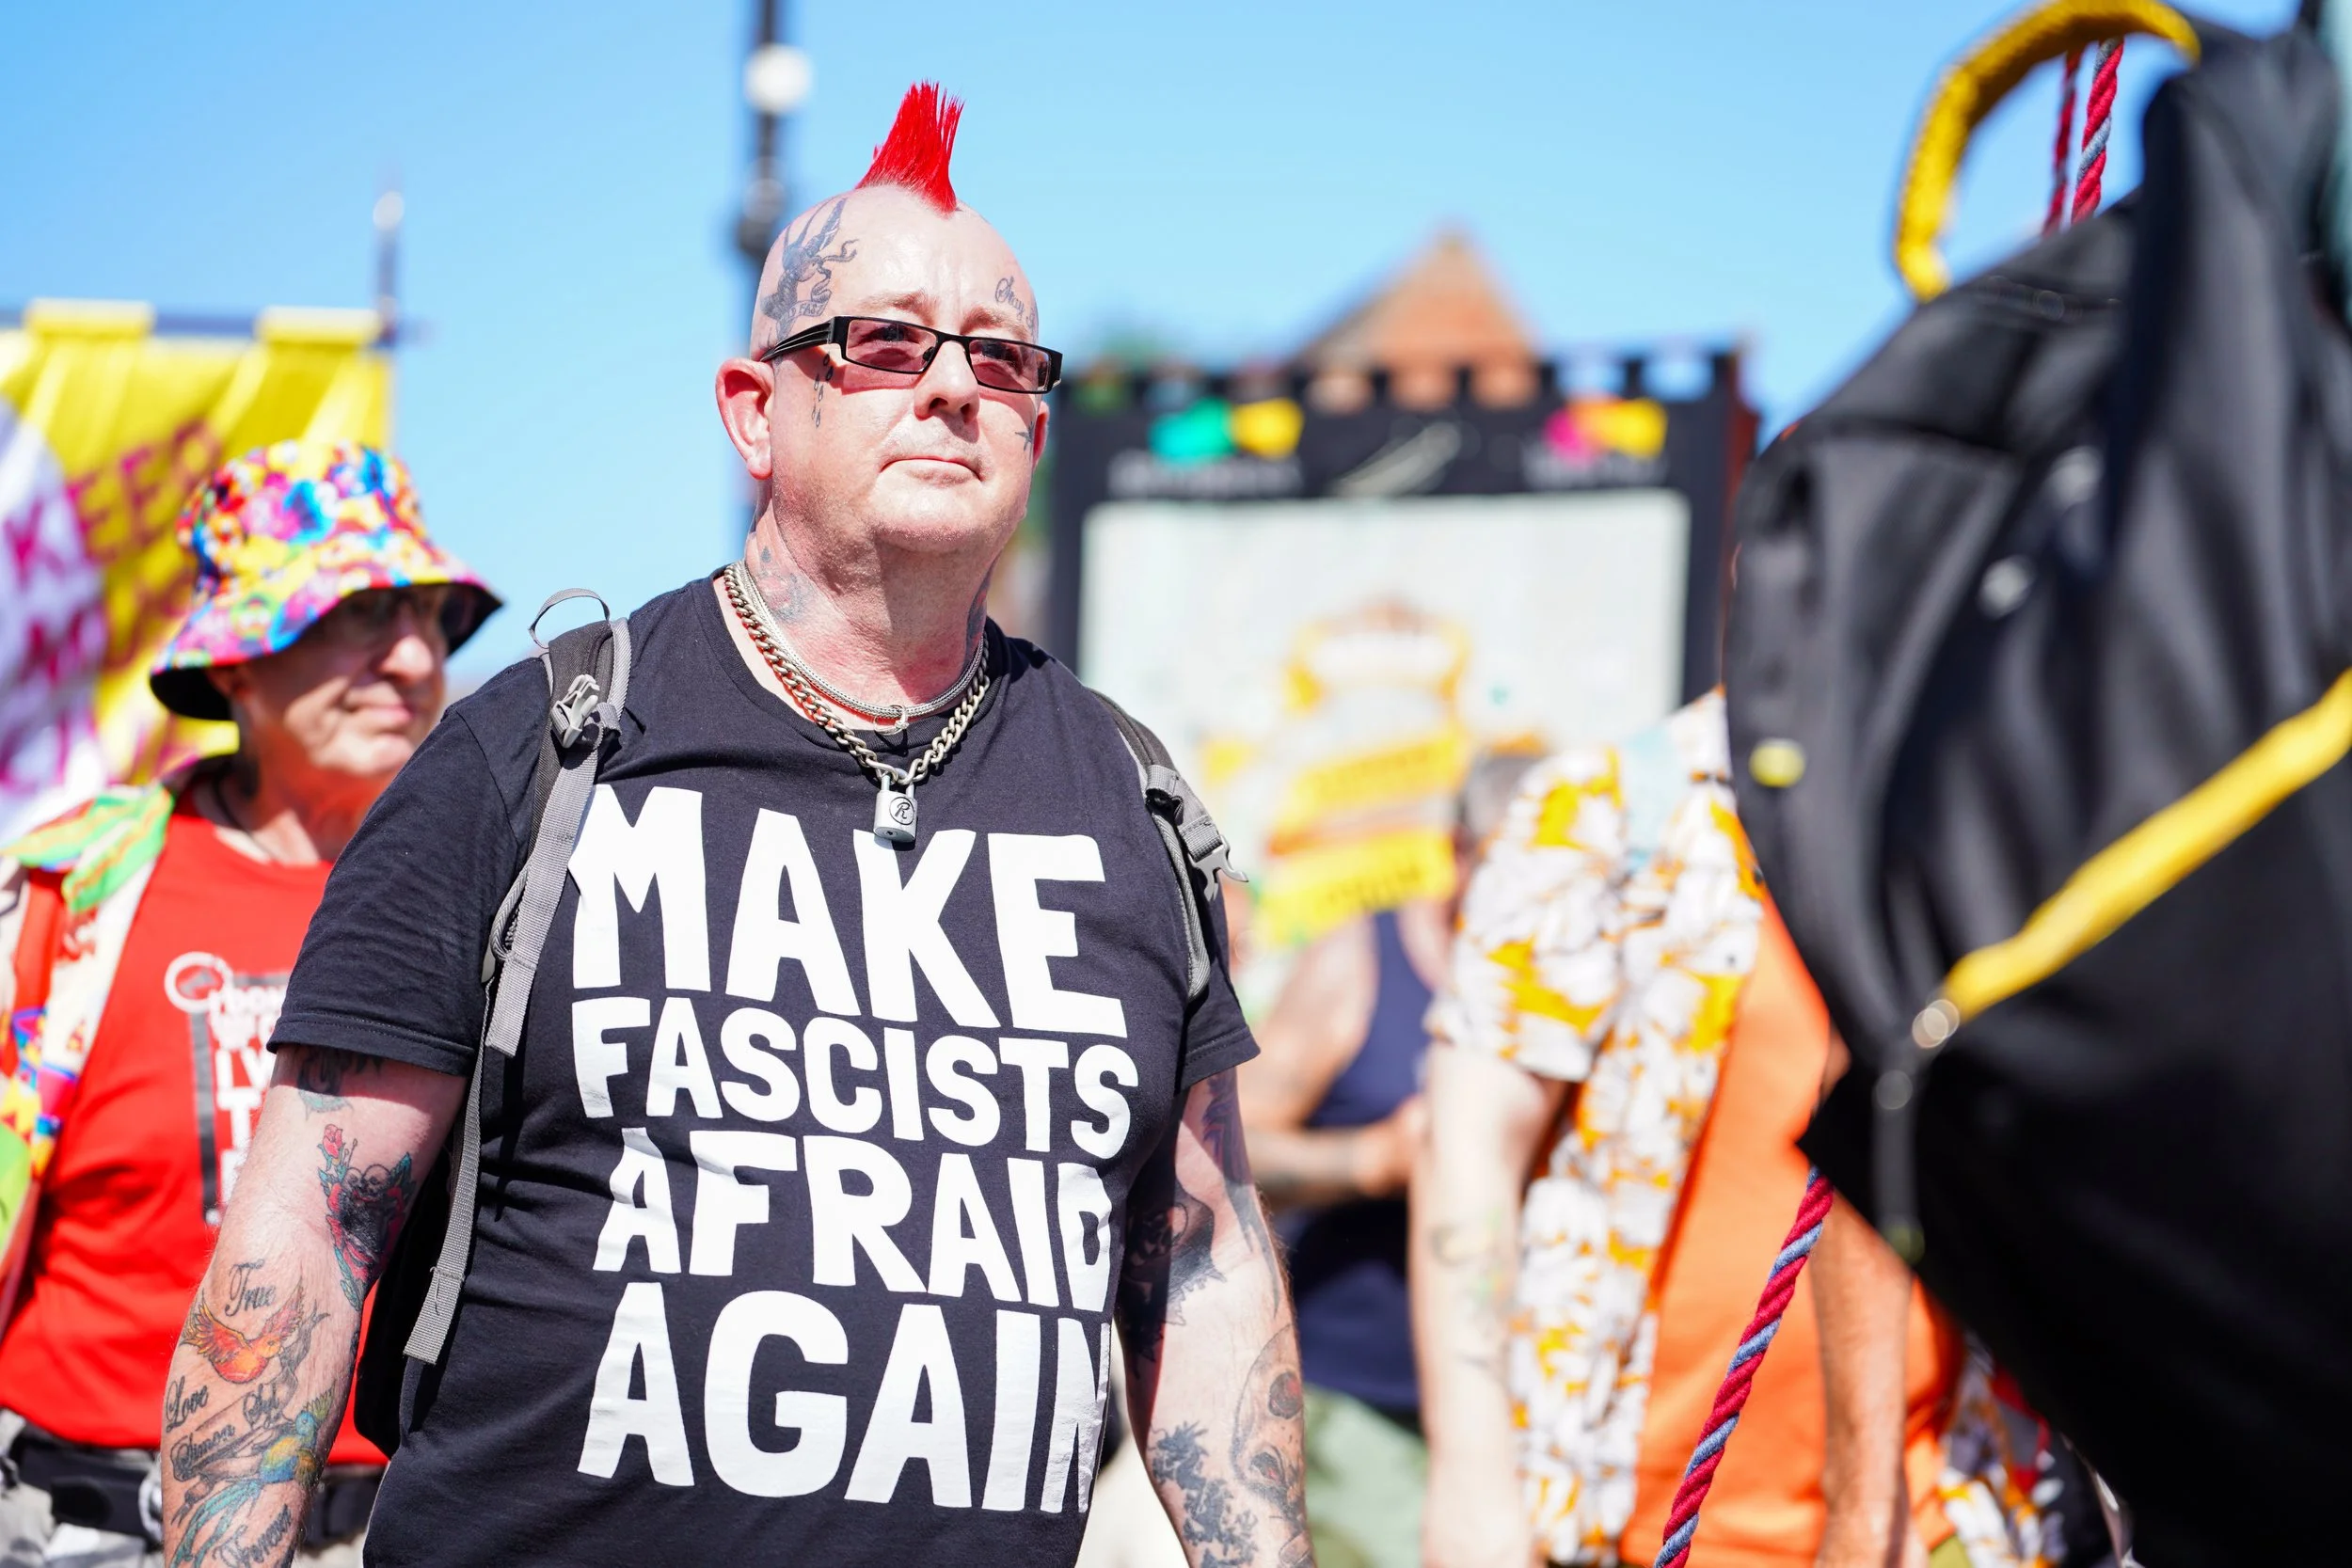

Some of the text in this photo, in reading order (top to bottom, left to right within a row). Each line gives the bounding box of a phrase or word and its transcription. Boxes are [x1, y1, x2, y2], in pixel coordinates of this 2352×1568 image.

[568, 784, 1127, 1038] MAKE
[571, 996, 1138, 1158] FASCISTS
[225, 1258, 277, 1317] True
[593, 1127, 1112, 1312] AFRAID
[166, 1374, 209, 1433] Love
[577, 1282, 1111, 1513] AGAIN
